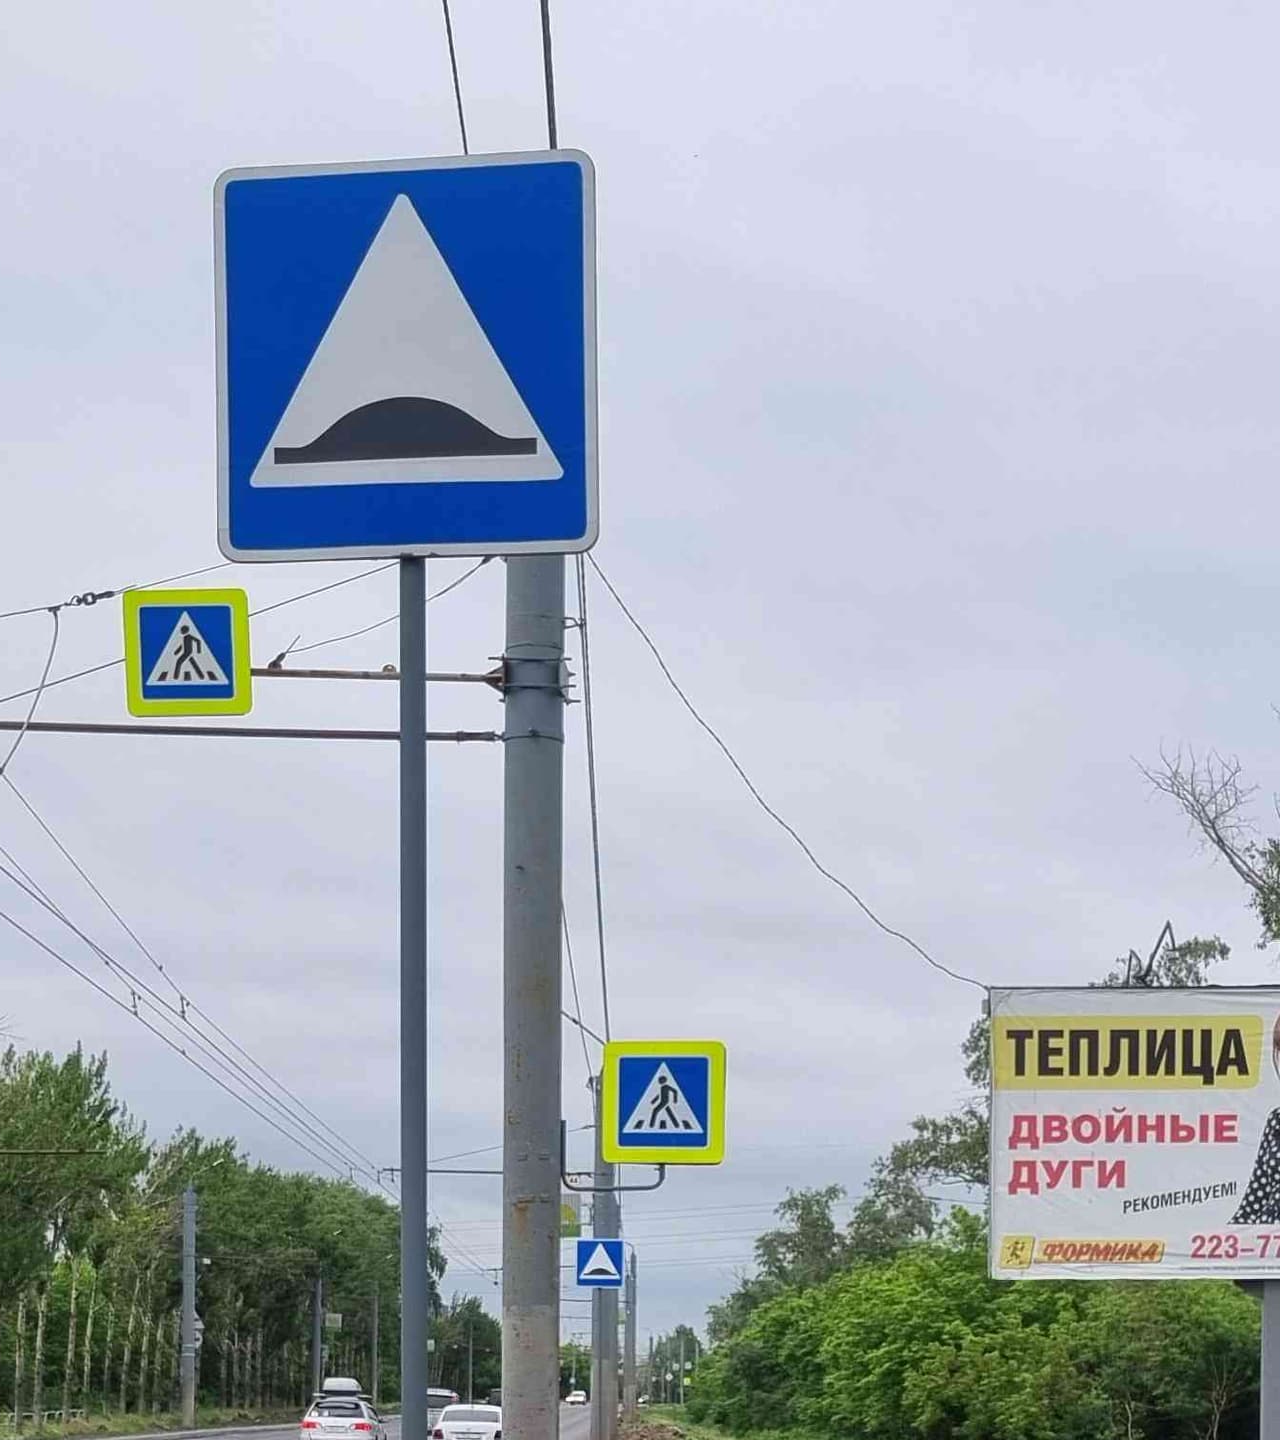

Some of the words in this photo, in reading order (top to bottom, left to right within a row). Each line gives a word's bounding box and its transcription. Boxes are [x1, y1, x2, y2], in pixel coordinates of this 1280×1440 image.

[1006, 1028, 1250, 1085] ТЕПЛИЦА
[1008, 1106, 1238, 1150] ДВОЙНЫЕ
[1008, 1160, 1126, 1195] ДУГИ
[1122, 1181, 1238, 1214] РЕКОМЕНДУЕМ!
[1042, 1242, 1160, 1262] ФОРМИКА
